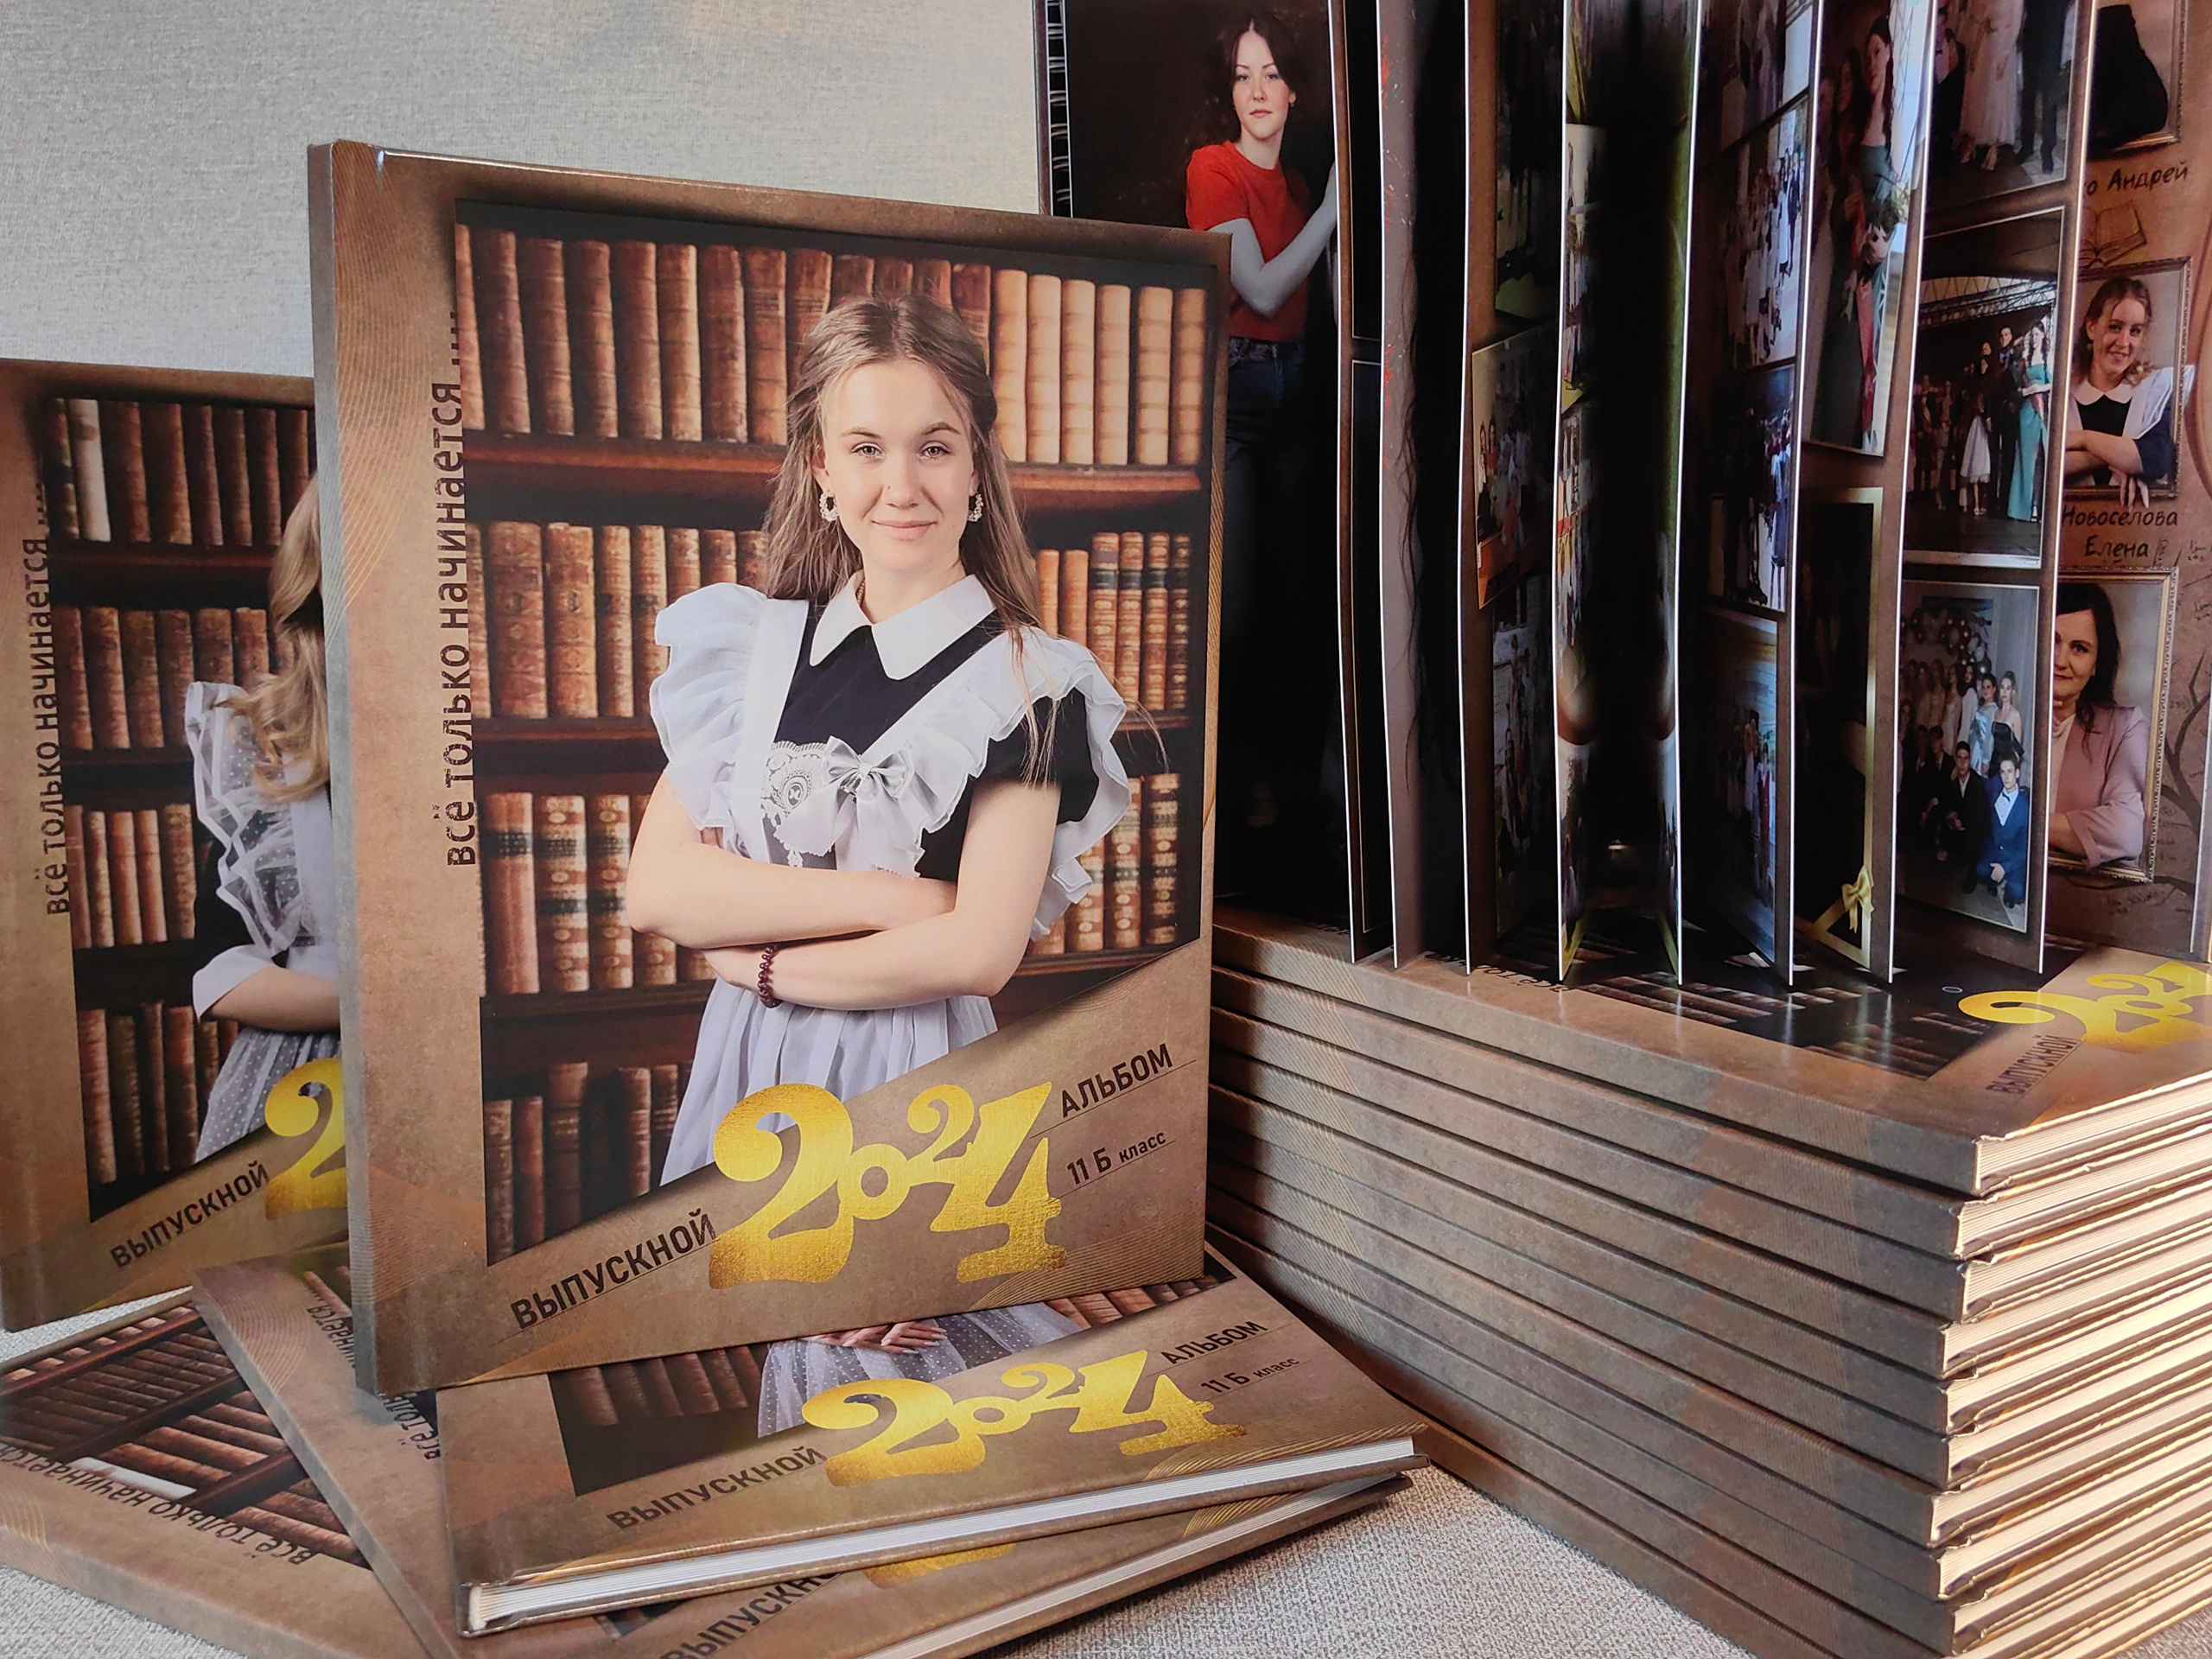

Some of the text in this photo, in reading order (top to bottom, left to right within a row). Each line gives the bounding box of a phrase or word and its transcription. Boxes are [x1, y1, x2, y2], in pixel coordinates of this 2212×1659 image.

[2107, 160, 2189, 192] Андрей
[2061, 505, 2178, 527] Новоселова
[2084, 534, 2149, 558] Елена
[440, 645, 474, 788] только
[36, 741, 66, 855] только
[432, 801, 476, 866] всё
[35, 863, 70, 915] всё
[1986, 1033, 2078, 1095] ВЫПУСКНОЙ
[1066, 1131, 1166, 1186] 11 Б класс
[110, 1159, 270, 1268] ВЫПУСКНОЙ
[511, 1043, 1173, 1330] ВЫПУСКНОЙ 2024 АЛЬБОМ
[1201, 1357, 1300, 1394] 11 Б класс
[606, 1321, 1268, 1530] ВЫПУСКНОЙ 2024 АЛЬБОМ
[149, 1501, 258, 1544] только
[245, 1535, 320, 1565] всё
